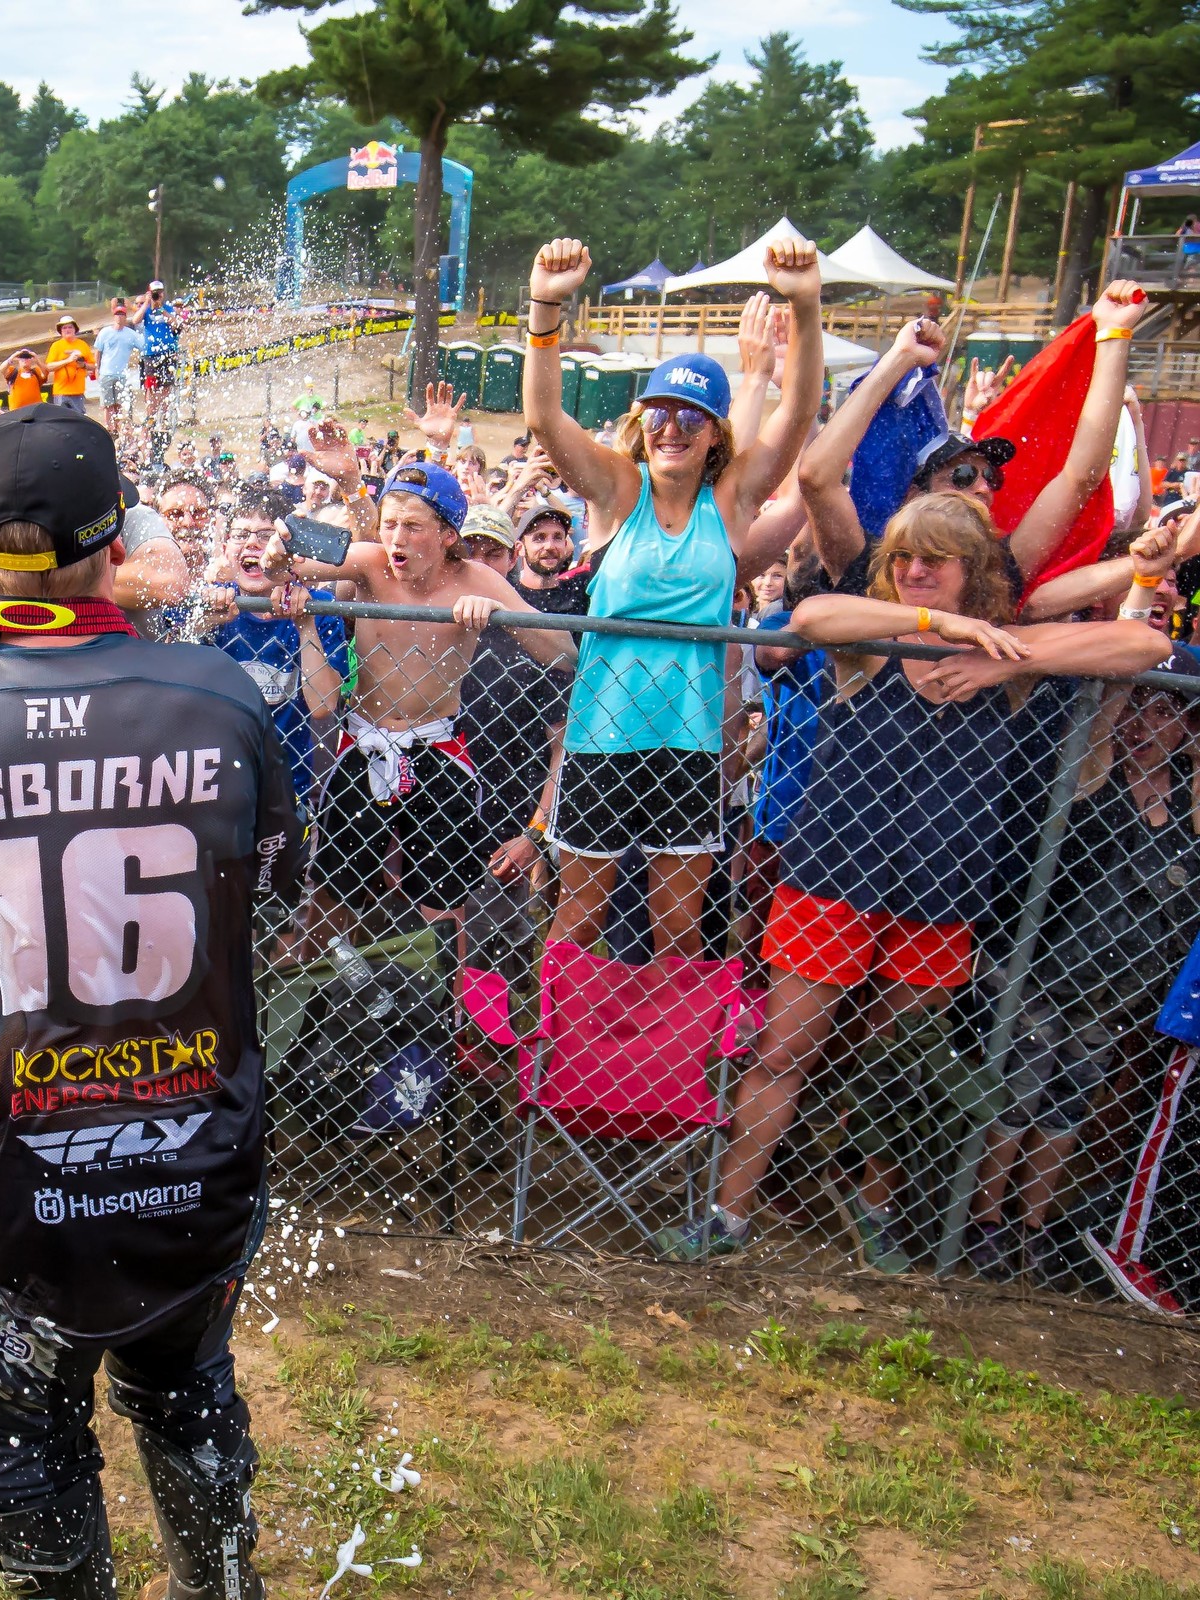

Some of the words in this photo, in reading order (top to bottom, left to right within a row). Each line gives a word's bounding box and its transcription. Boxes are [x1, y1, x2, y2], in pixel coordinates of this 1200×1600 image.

[670, 367, 710, 390] WICK
[23, 694, 91, 730] FLY
[26, 728, 88, 740] RACING
[11, 1082, 120, 1116] ENERGY
[133, 1069, 219, 1101] DRINK
[16, 1111, 212, 1165] FLY
[61, 1151, 178, 1175] RACING
[69, 1181, 202, 1219] Husqvarna
[137, 1208, 173, 1220] FACTORY
[174, 1202, 201, 1216] RACING
